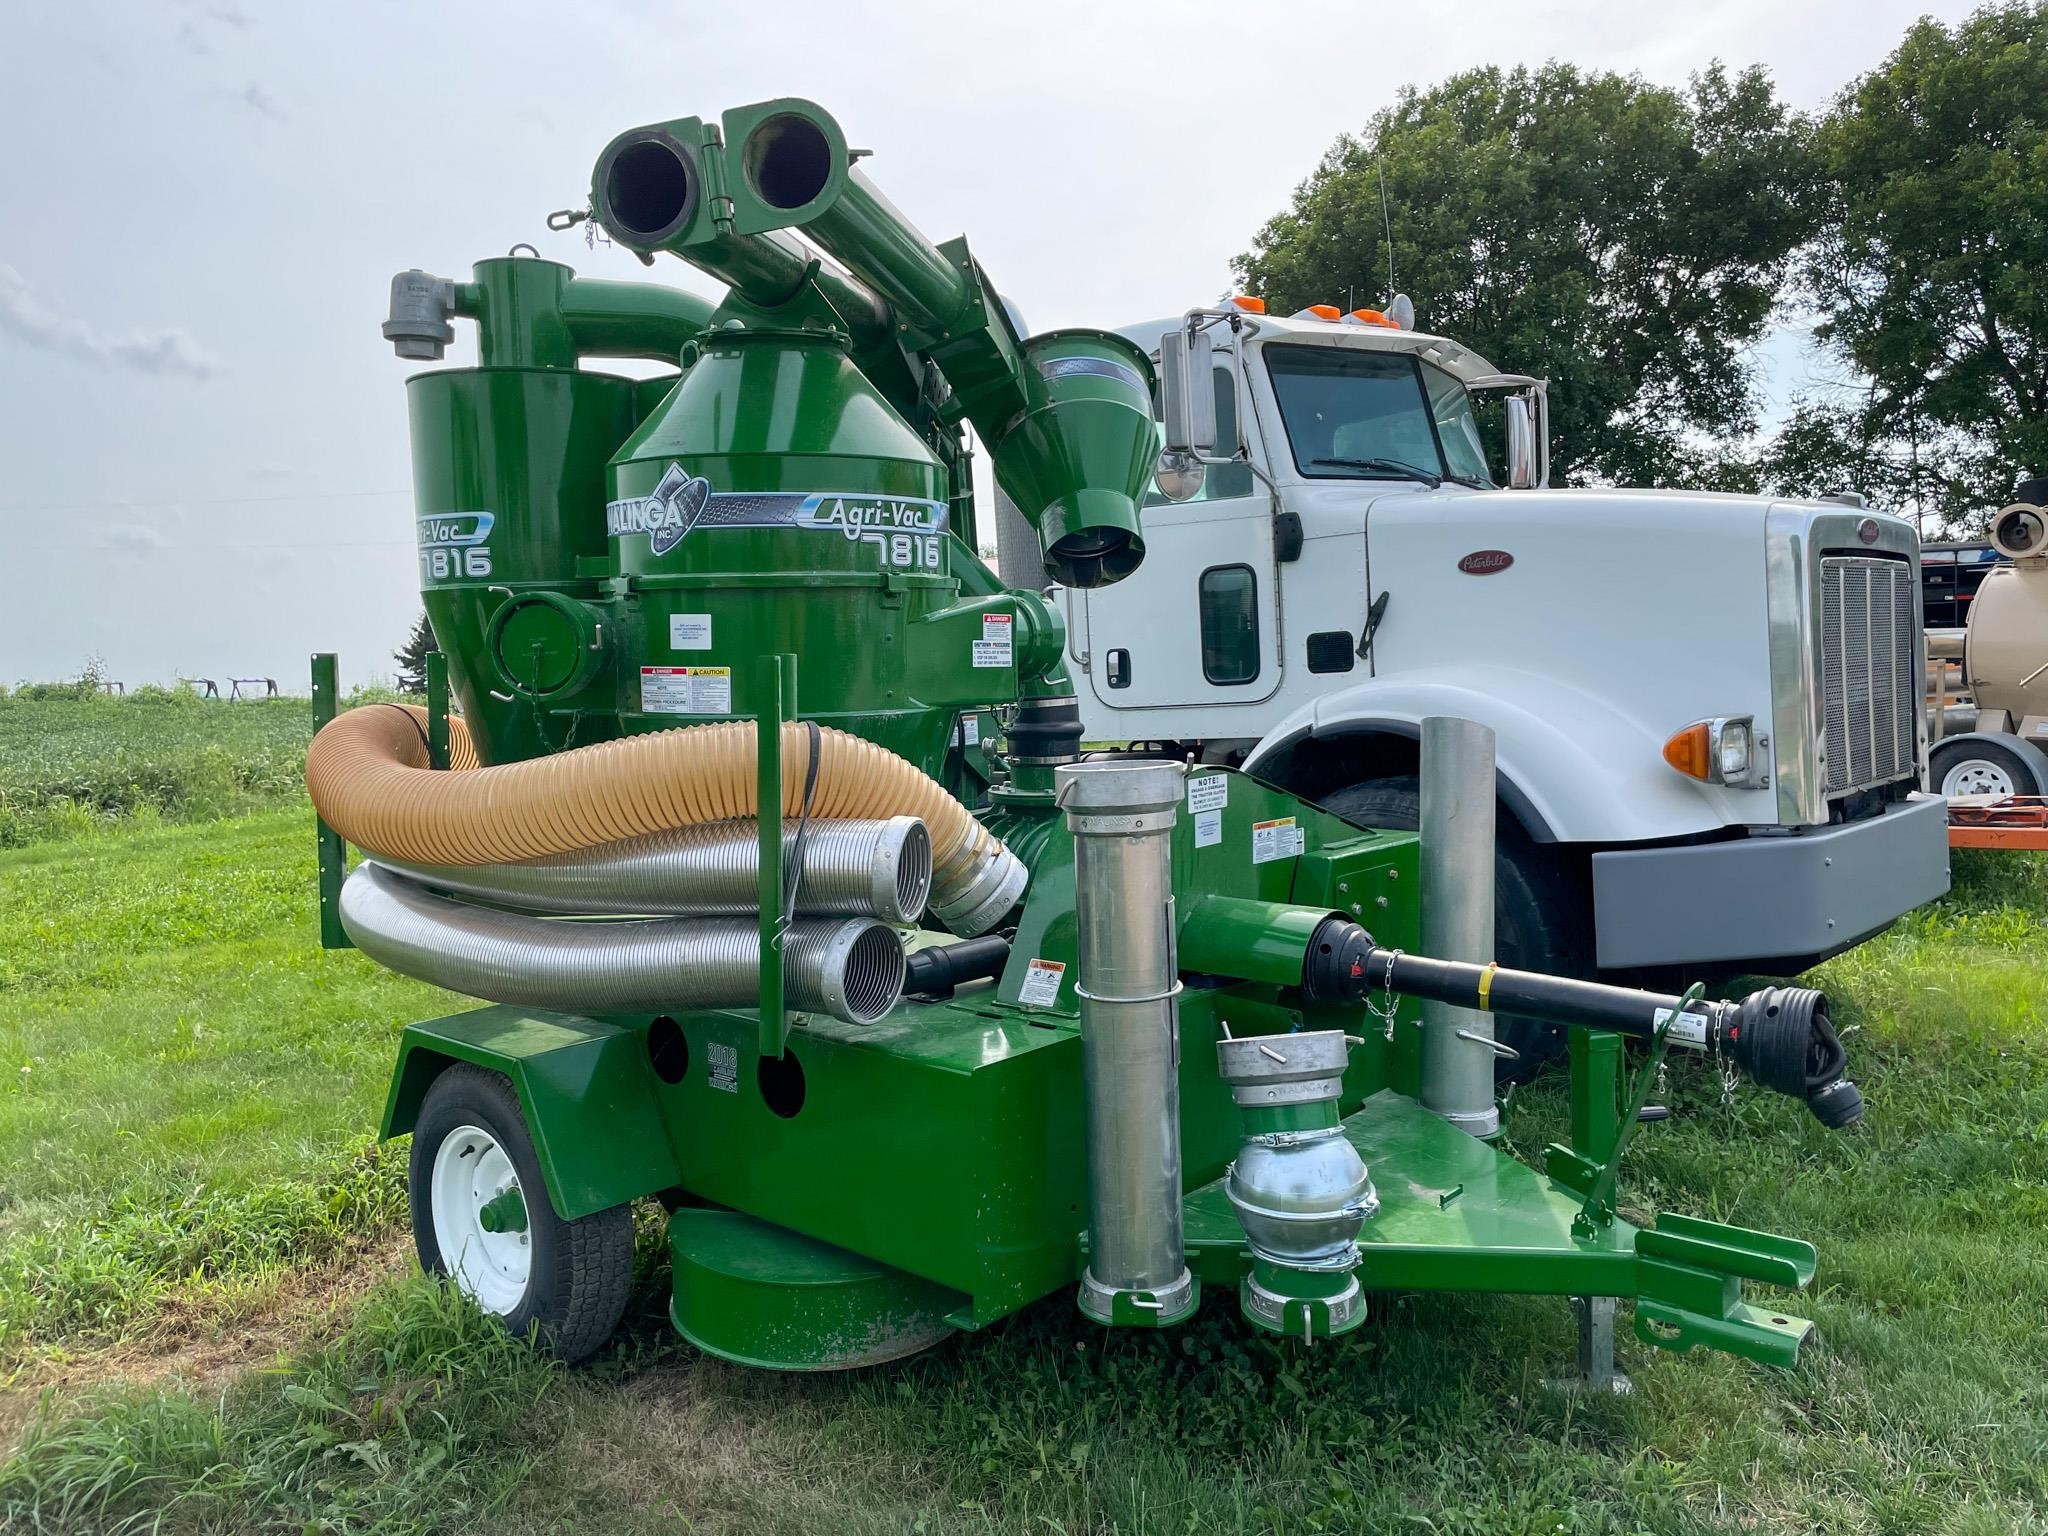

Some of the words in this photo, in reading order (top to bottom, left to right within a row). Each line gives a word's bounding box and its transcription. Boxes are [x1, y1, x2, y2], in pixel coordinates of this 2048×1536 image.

[607, 497, 688, 536] WALINGA
[826, 498, 928, 541] Agri-Vac
[657, 530, 673, 539] INC.
[861, 533, 939, 568] 7816
[1463, 554, 1508, 571] Peterbilt
[1198, 776, 1219, 786] NOTE!
[1039, 961, 1062, 970] WARNING
[707, 1042, 738, 1067] 2018
